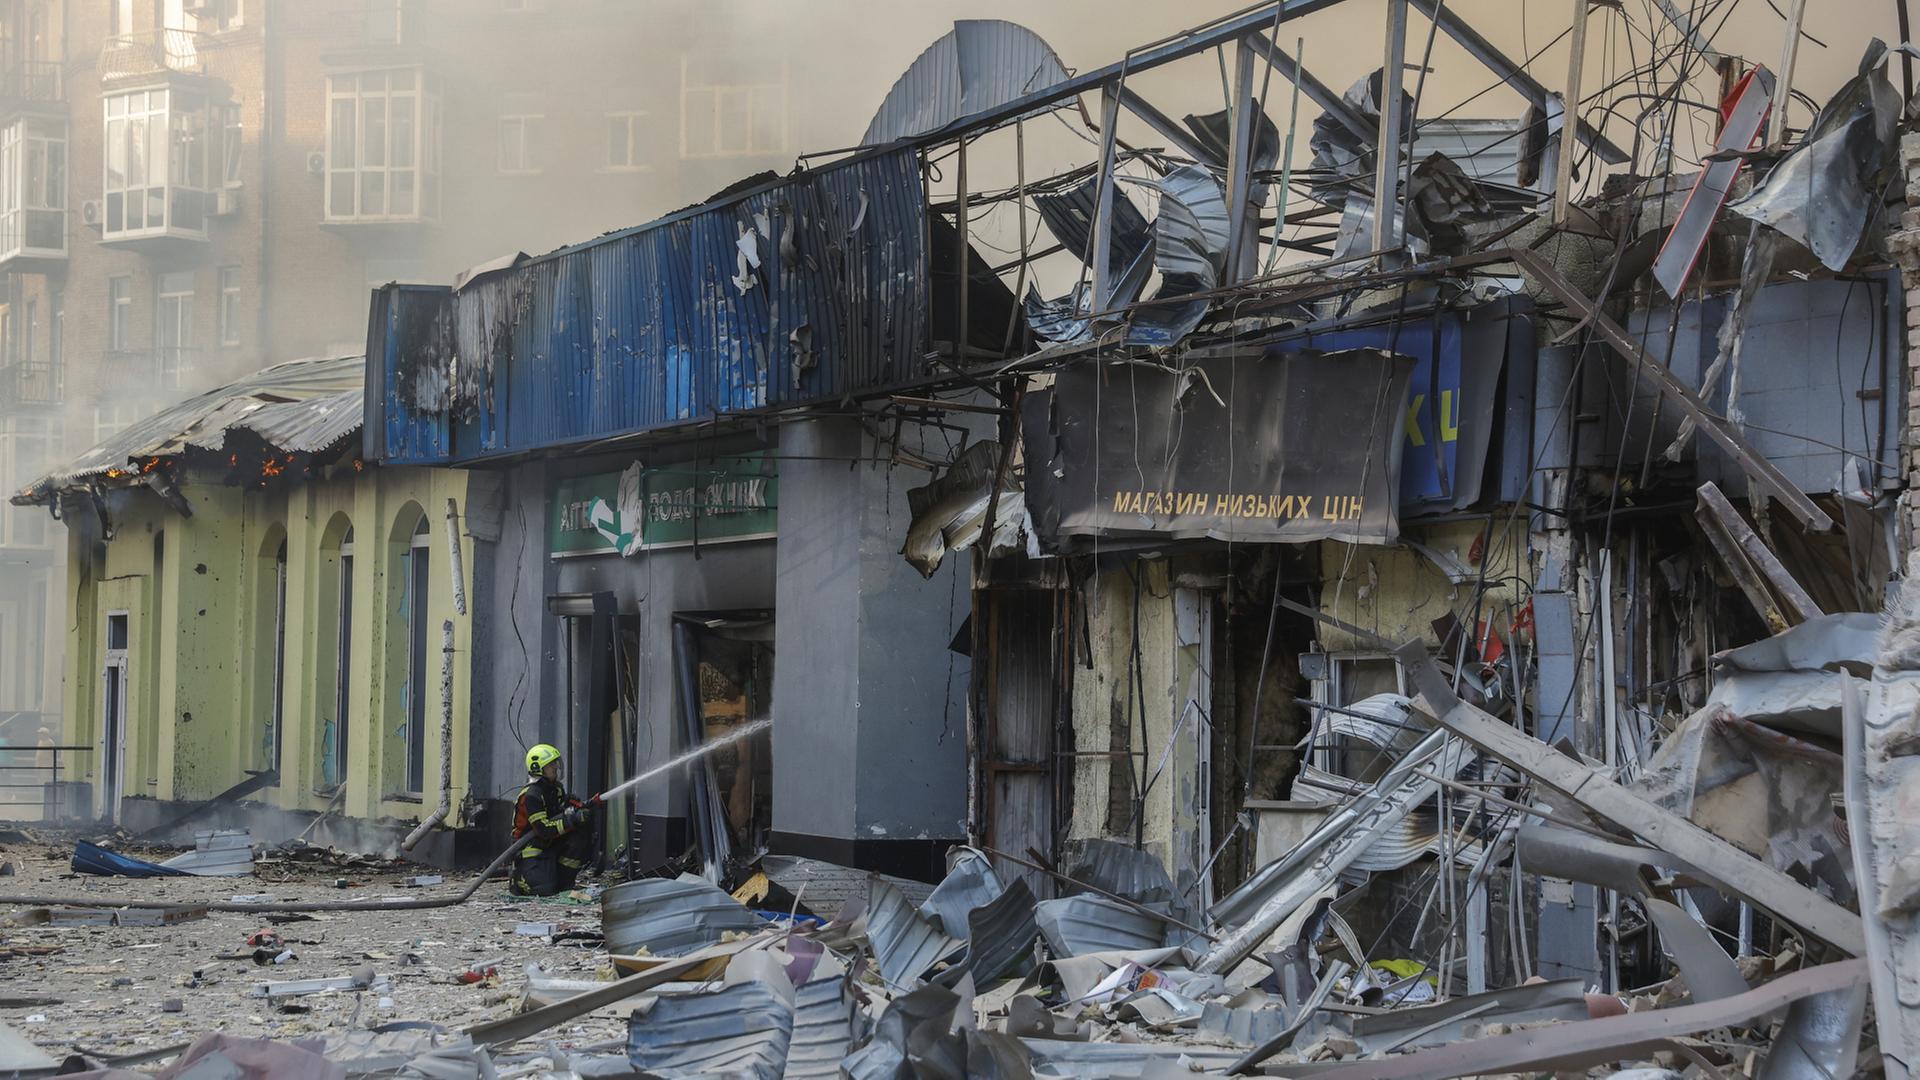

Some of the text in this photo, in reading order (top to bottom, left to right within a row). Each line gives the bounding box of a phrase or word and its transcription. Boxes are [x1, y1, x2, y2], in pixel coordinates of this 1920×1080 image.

[560, 479, 767, 532] АПТЕ ПОДООЖНИК
[1113, 491, 1364, 523] МАГАЗИН НИЗЬКИХ ЦІН
